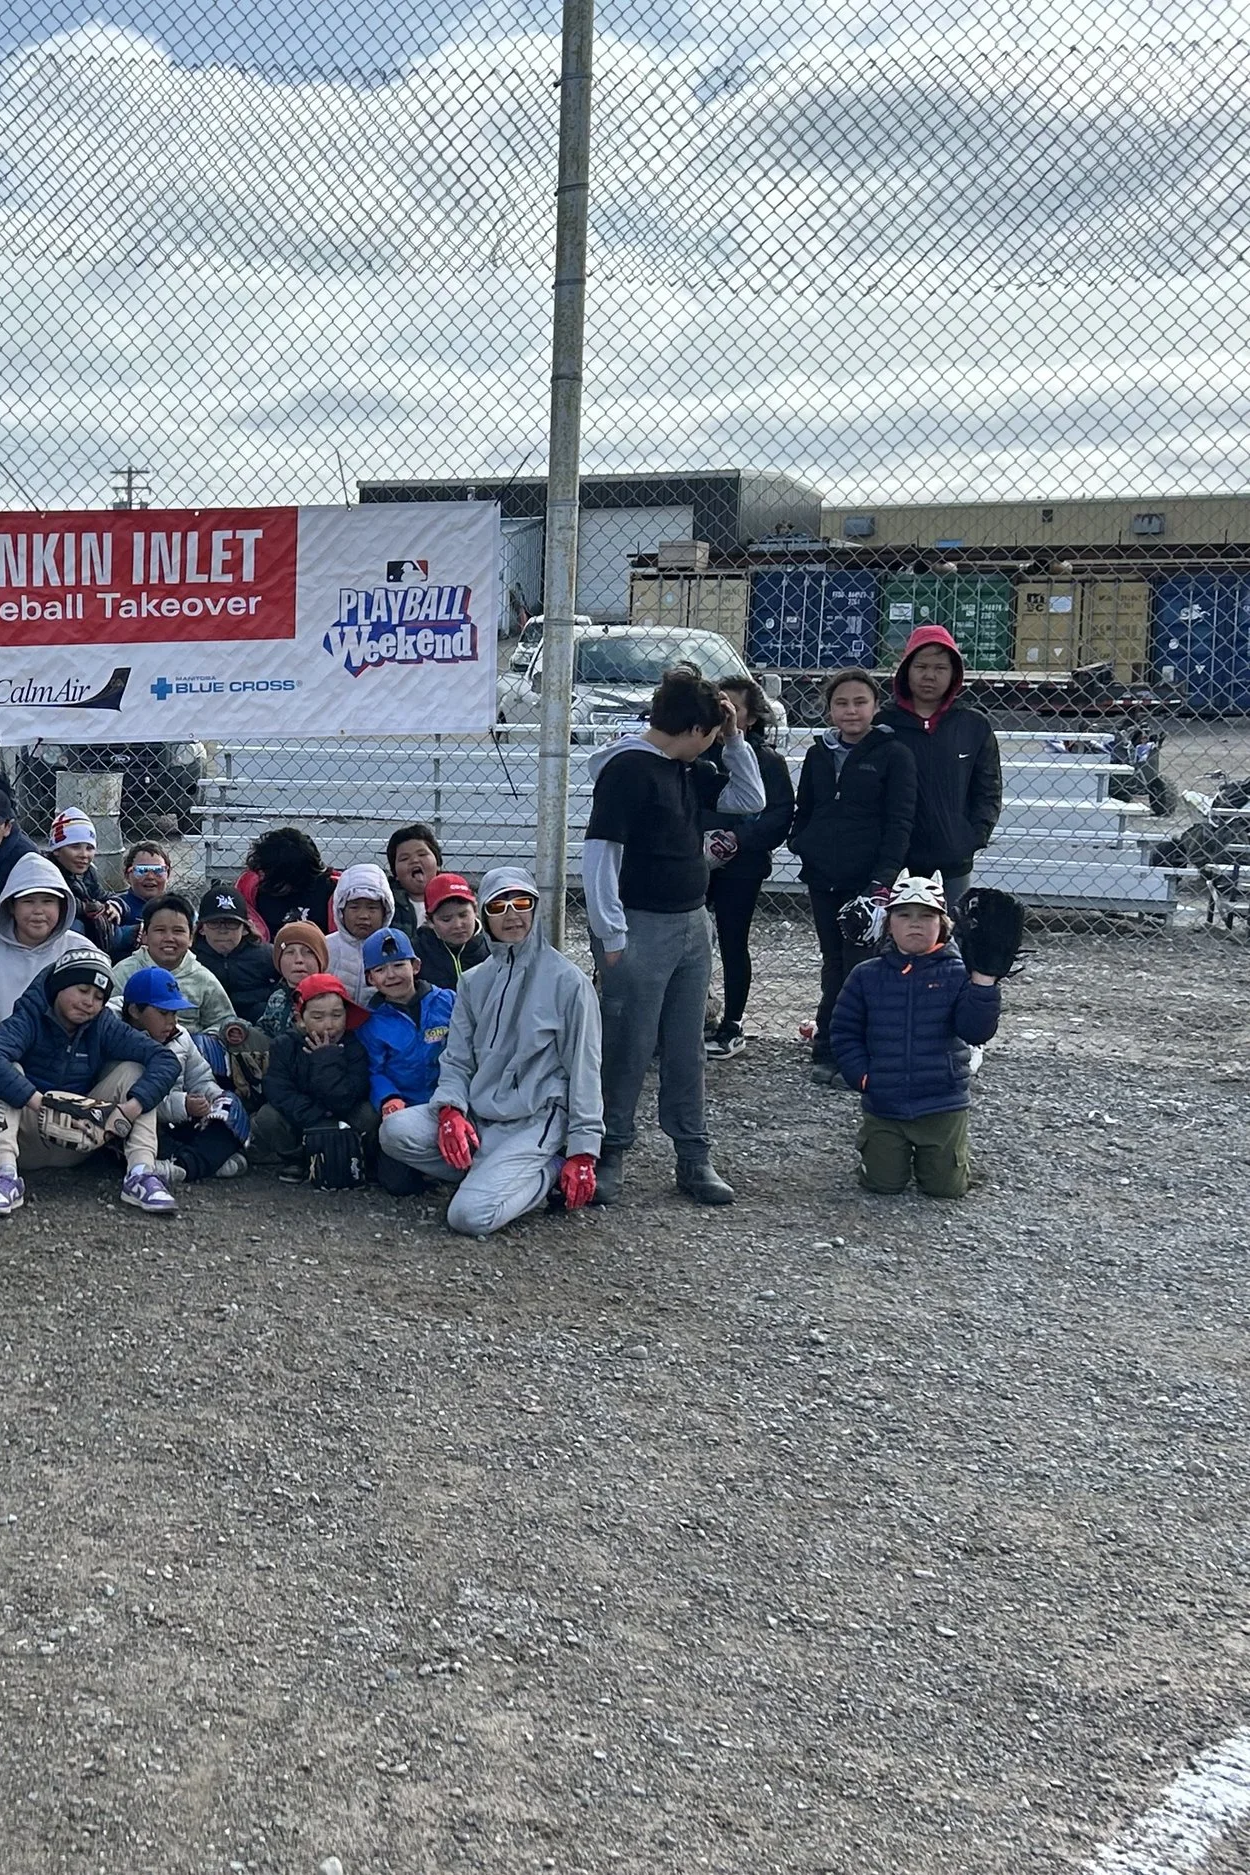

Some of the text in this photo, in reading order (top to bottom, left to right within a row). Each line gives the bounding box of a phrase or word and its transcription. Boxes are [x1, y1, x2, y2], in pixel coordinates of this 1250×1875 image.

[132, 529, 263, 586] INLET
[97, 592, 262, 619] Takeover
[329, 624, 473, 668] Weekend
[175, 680, 296, 694] BLUE CROSS
